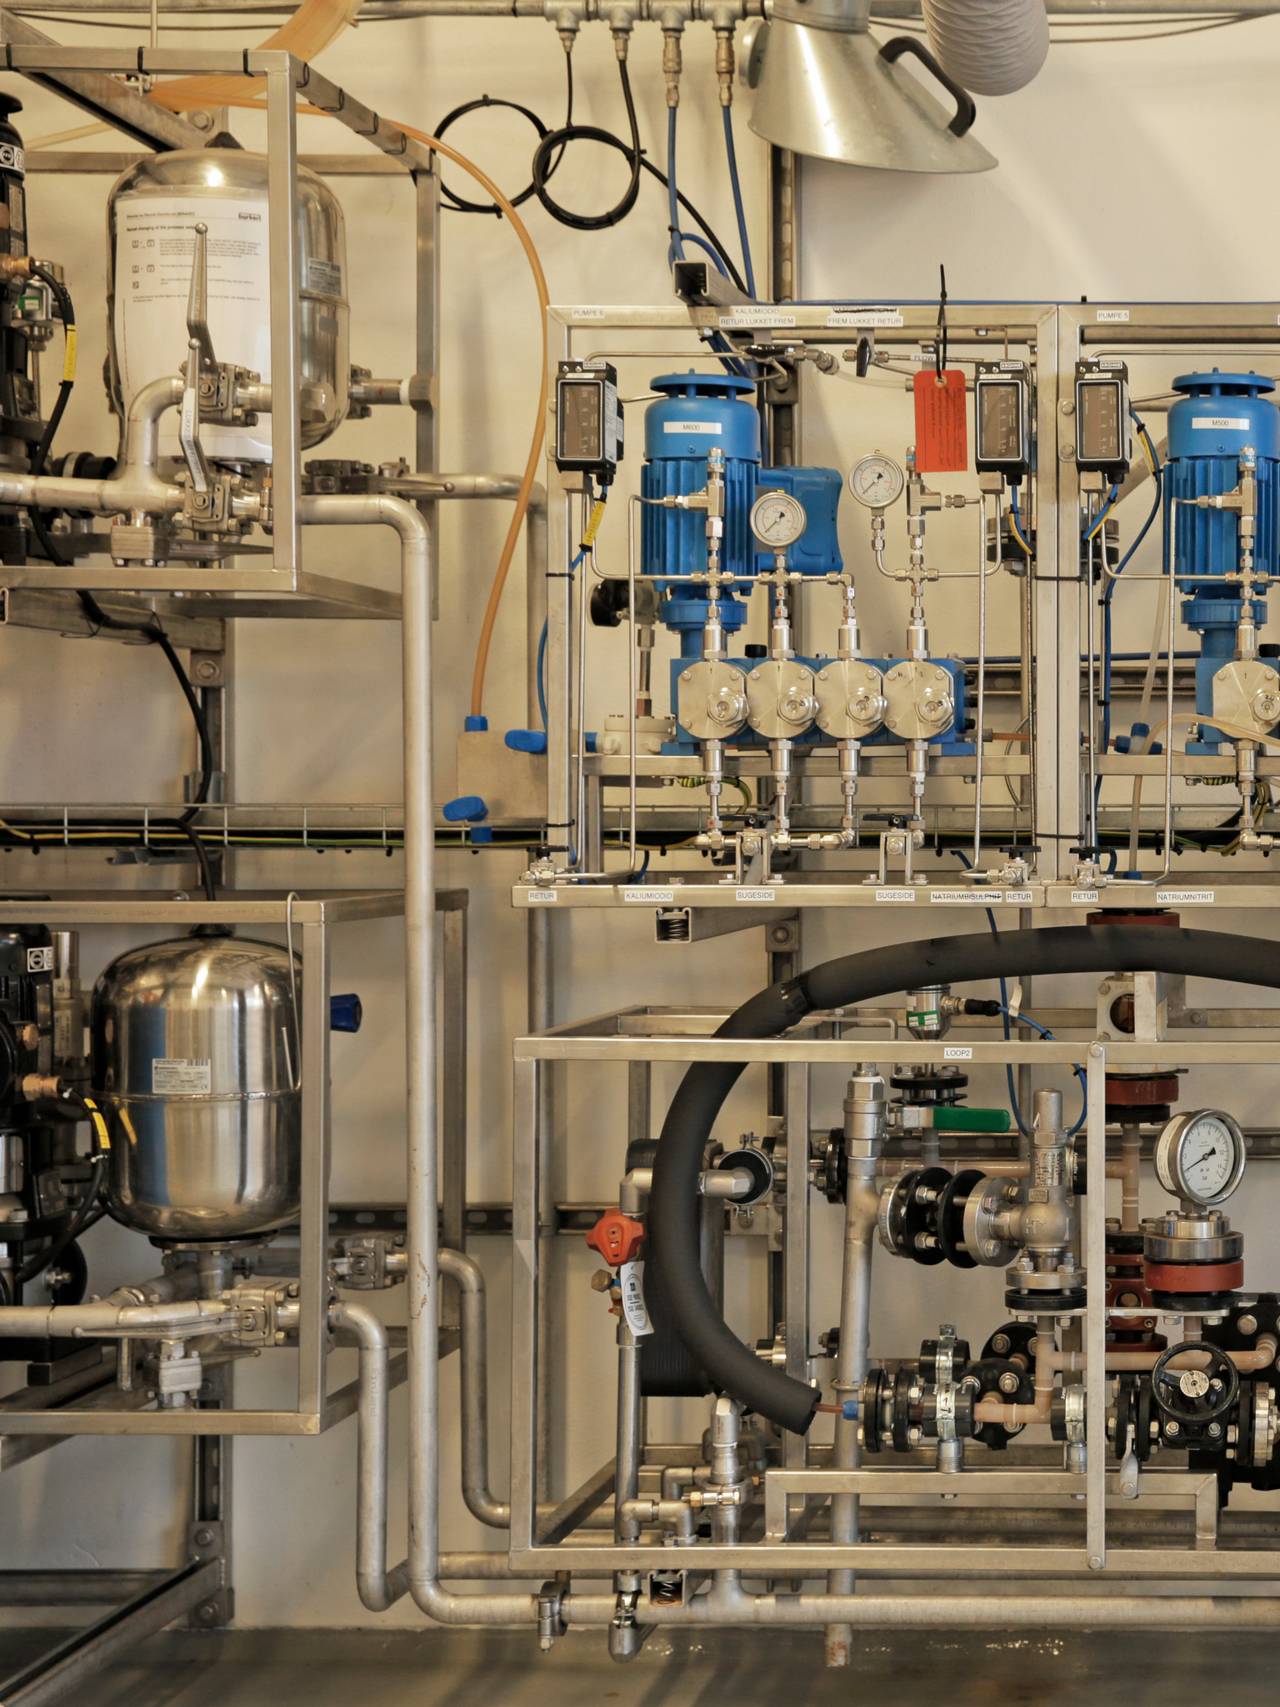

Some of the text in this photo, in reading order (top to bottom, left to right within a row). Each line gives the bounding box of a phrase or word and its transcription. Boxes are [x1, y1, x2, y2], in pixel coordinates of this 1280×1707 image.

[530, 892, 554, 900] RETUR
[737, 891, 774, 899] SUGESIDE
[877, 891, 914, 899] SUGESIDE
[1007, 892, 1031, 900] RETUR
[1073, 892, 1097, 900] RETUR
[1158, 893, 1213, 901] NATRIUMNITRIT
